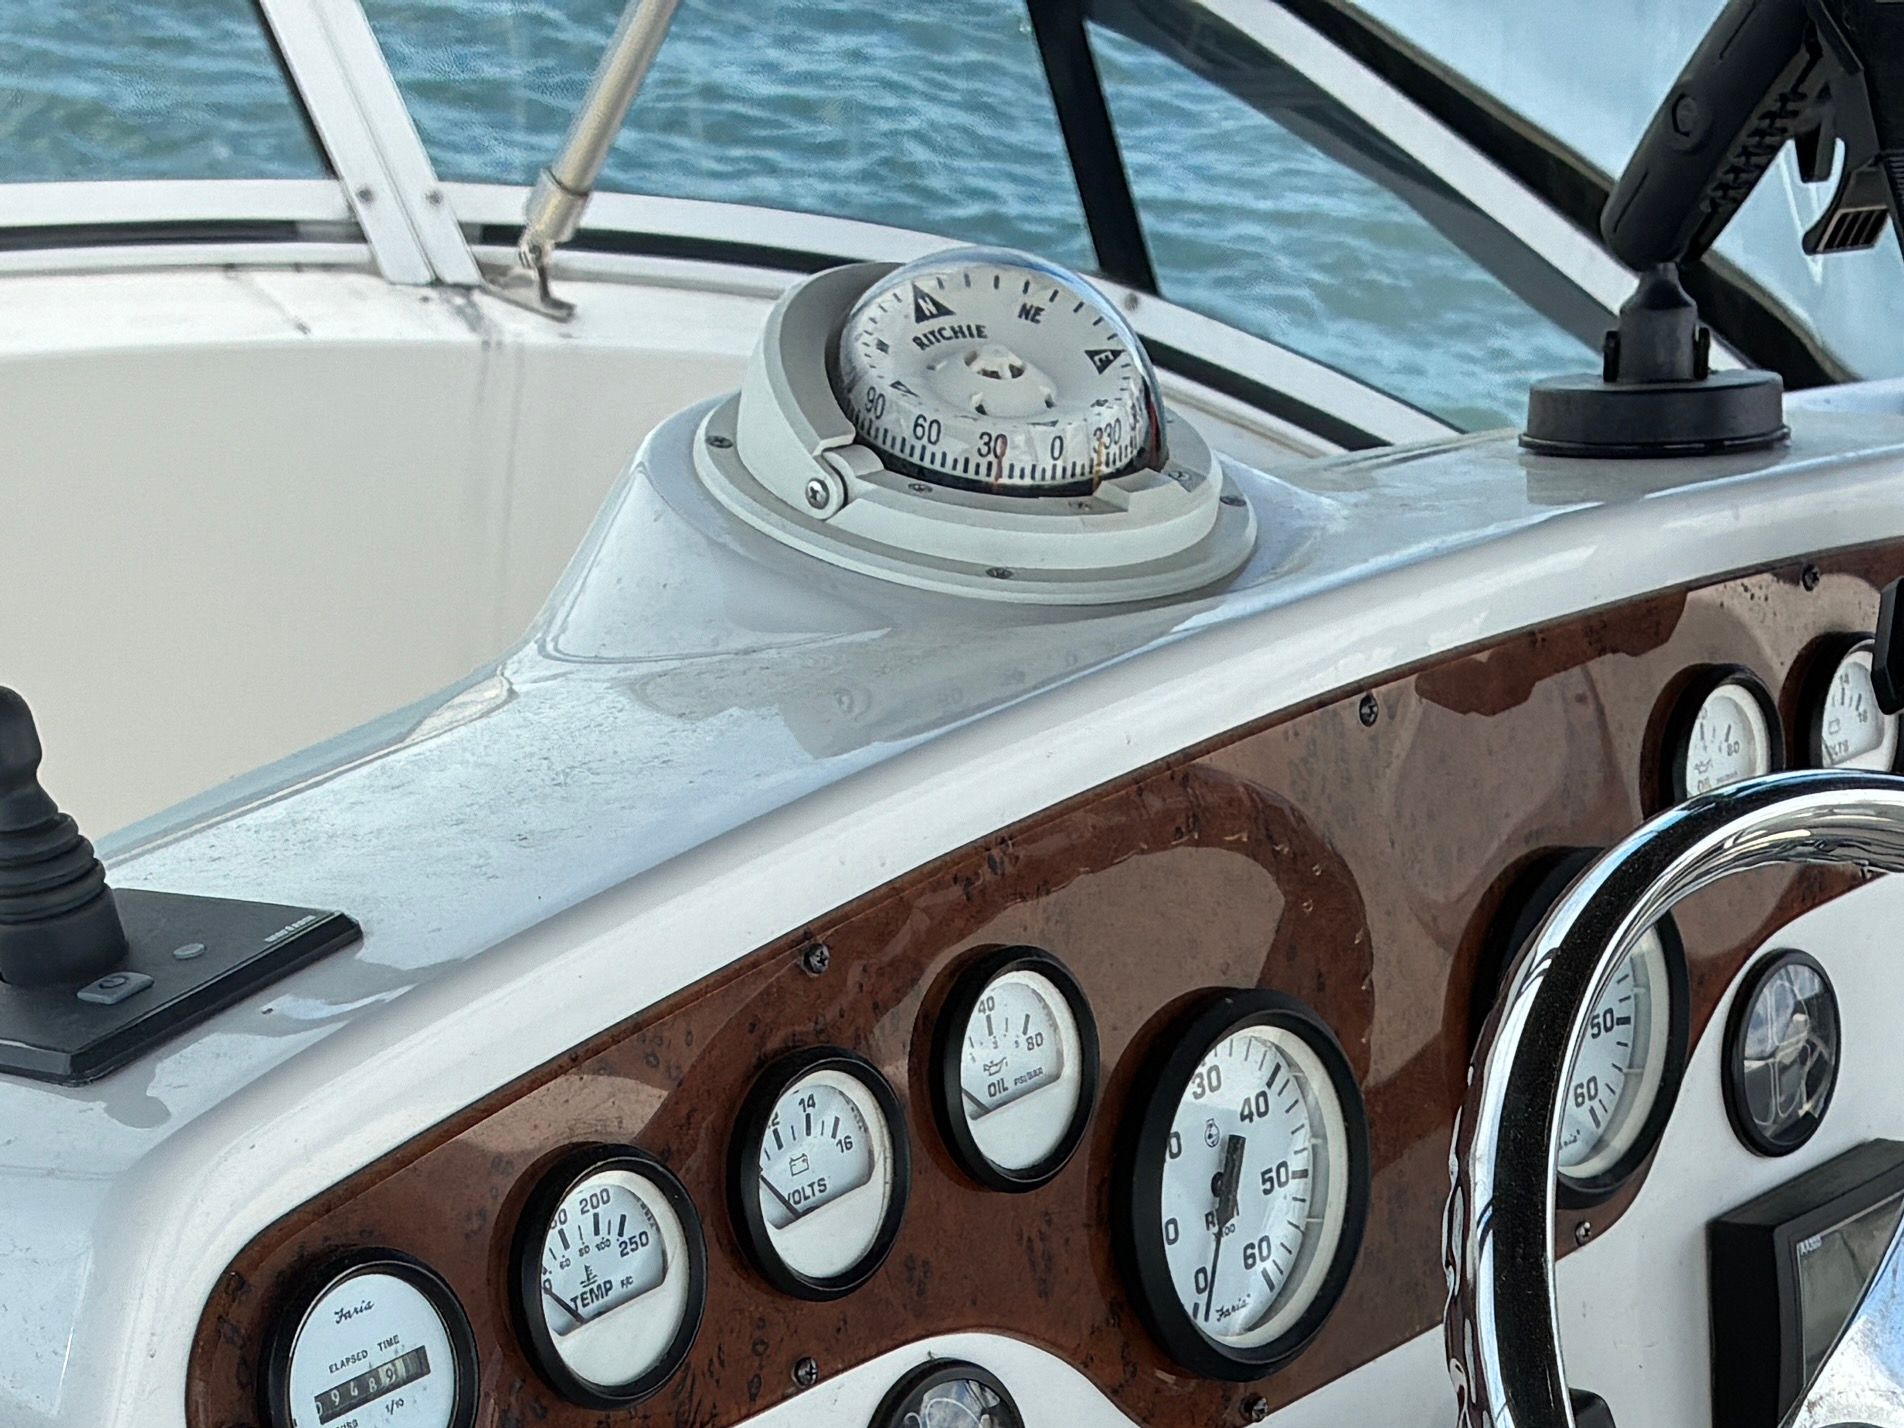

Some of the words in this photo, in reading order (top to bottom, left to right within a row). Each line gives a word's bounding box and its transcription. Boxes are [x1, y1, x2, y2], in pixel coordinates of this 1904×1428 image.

[1017, 302, 1045, 324] NE
[911, 323, 988, 350] RITCHIE
[864, 386, 886, 419] 90
[912, 413, 942, 445] 60
[977, 431, 1008, 459] 30
[1050, 435, 1064, 461] 0
[978, 996, 995, 1015] 40
[1590, 1007, 1614, 1040] 50
[1026, 1031, 1044, 1052] 80
[987, 1077, 1009, 1099] OIL
[1192, 1064, 1222, 1100] 30
[1574, 1075, 1599, 1108] 60
[798, 1093, 816, 1113] 14
[1239, 1089, 1270, 1124] 40
[835, 1135, 854, 1154] 16
[1260, 1160, 1290, 1196] 50
[579, 1187, 612, 1216] 200
[618, 1230, 650, 1259] 250
[1242, 1235, 1272, 1271] 60
[1194, 1265, 1209, 1295] 0
[570, 1279, 614, 1313] TEMP
[333, 1299, 376, 1325] Faria
[328, 1349, 369, 1374] ELAPSED
[376, 1334, 401, 1352] TIME
